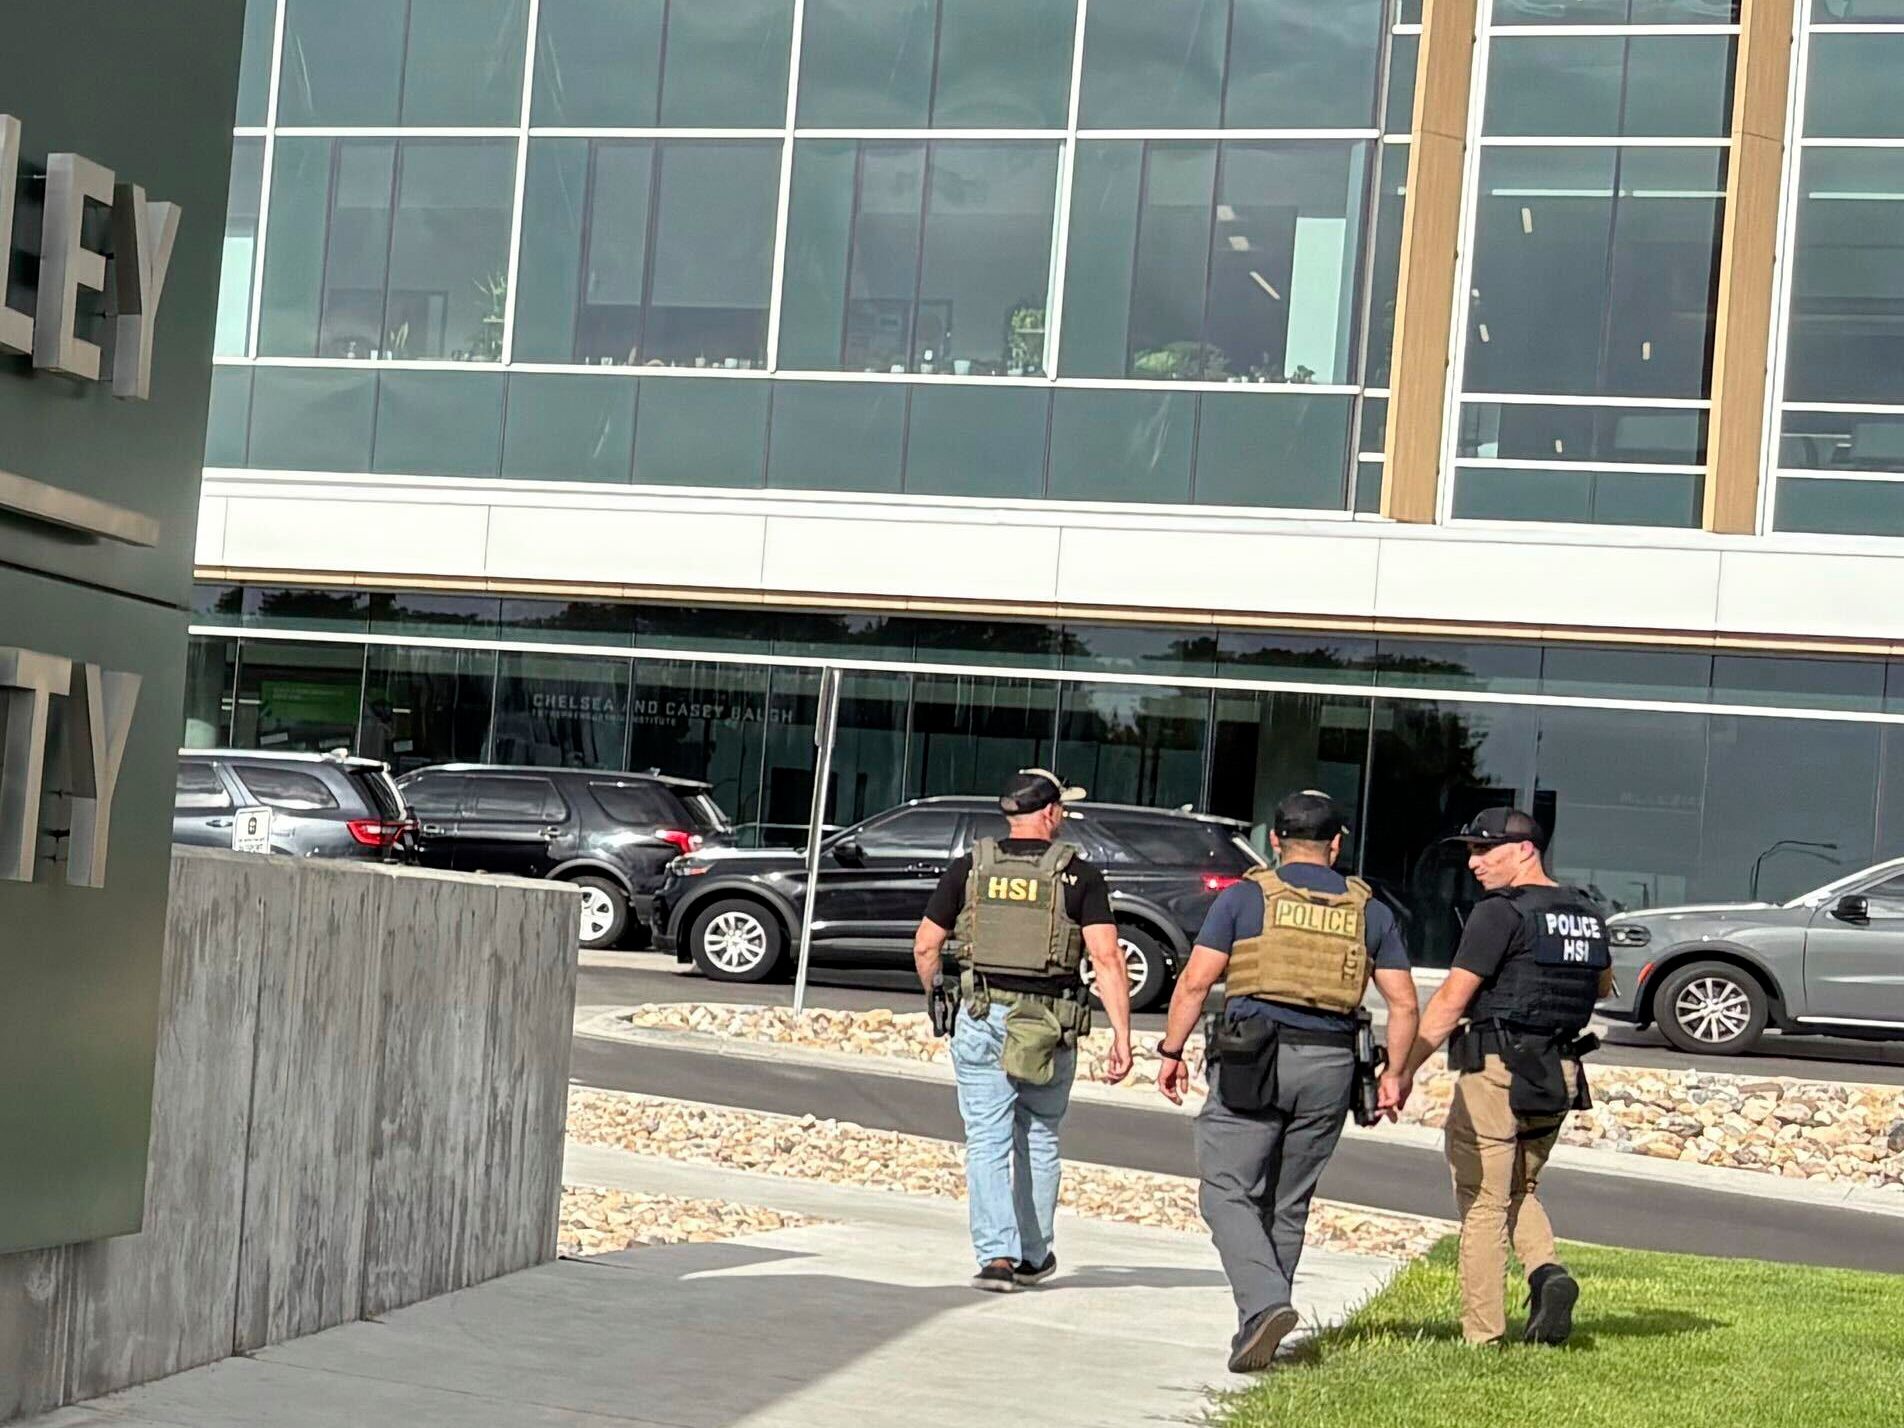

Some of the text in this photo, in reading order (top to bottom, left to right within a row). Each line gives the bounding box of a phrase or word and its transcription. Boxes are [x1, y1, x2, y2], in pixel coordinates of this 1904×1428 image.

[532, 692, 614, 711] CHELSEA
[665, 701, 724, 718] CASEY
[988, 876, 1038, 901] HSI
[1278, 902, 1354, 934] POLICE
[1545, 913, 1601, 939] POLICE
[1563, 939, 1589, 962] HSI
